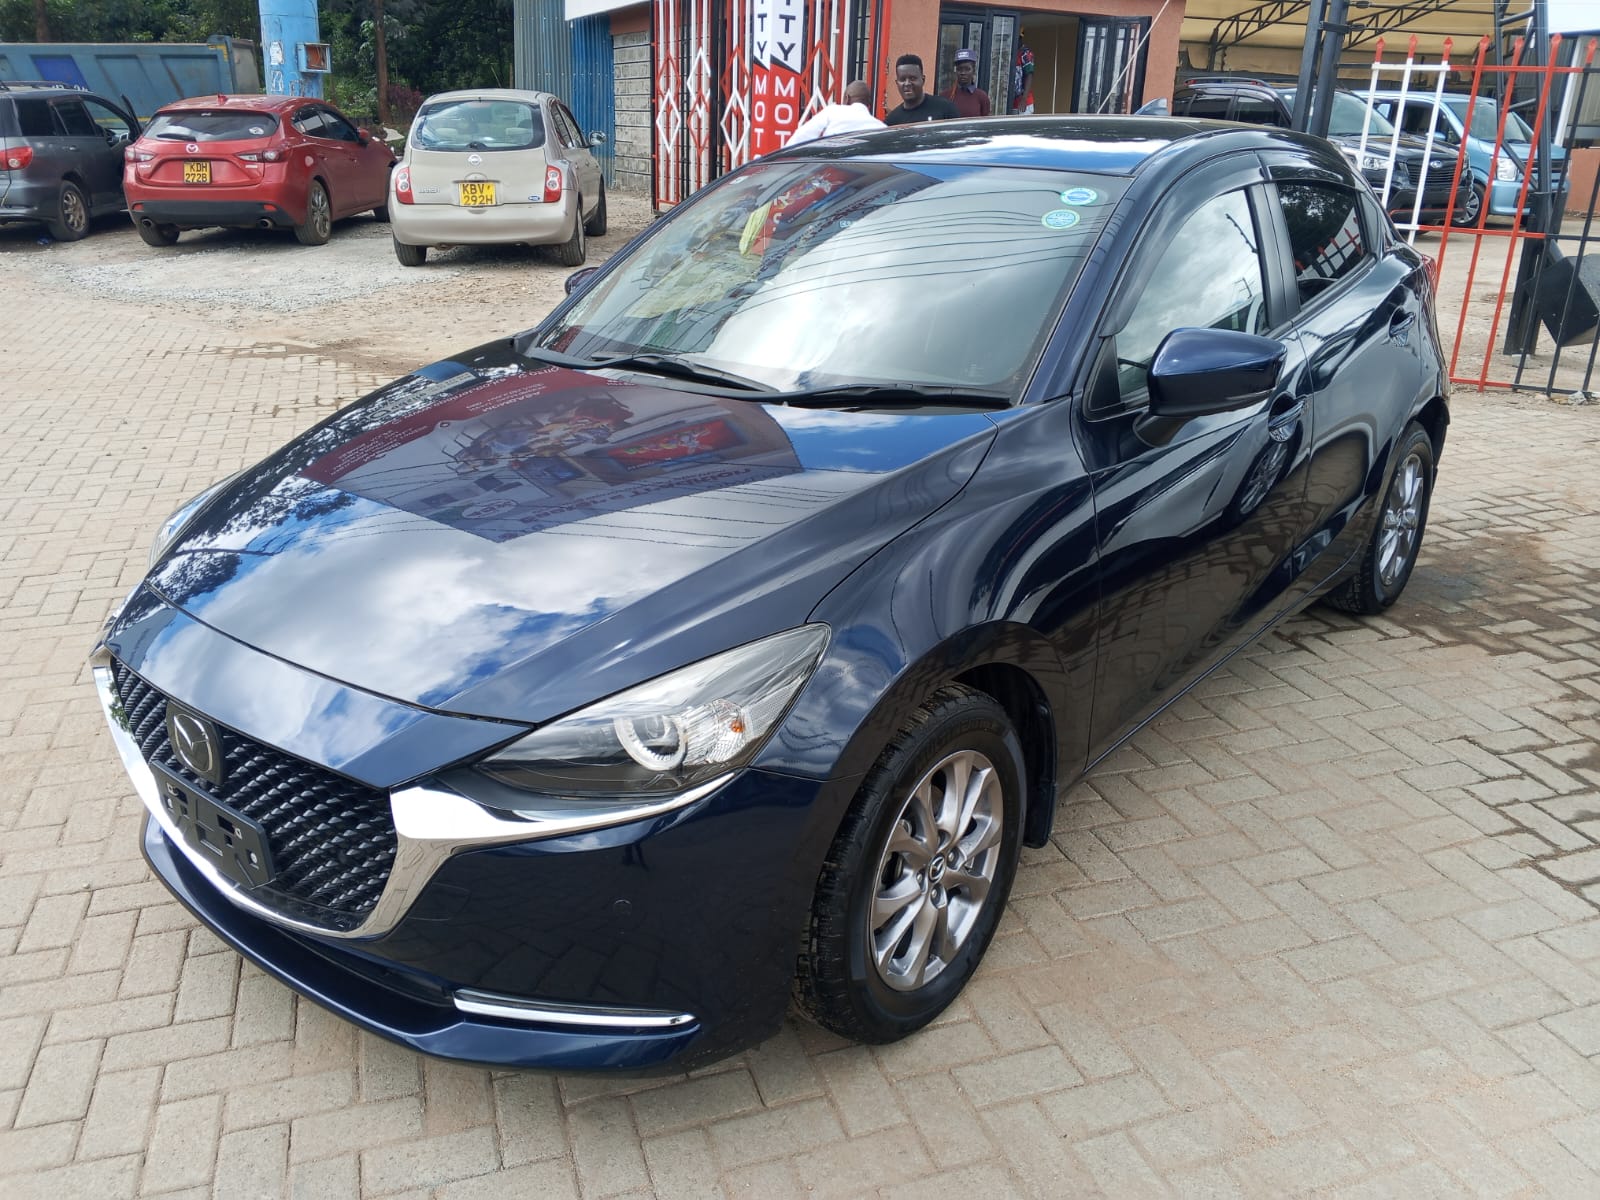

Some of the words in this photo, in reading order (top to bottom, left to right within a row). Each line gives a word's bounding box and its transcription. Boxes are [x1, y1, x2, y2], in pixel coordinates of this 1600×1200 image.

[757, 0, 767, 59] TY
[777, 0, 796, 61] TY
[754, 74, 767, 159] MOT
[190, 162, 208, 172] KDH
[185, 172, 208, 183] 272B
[462, 183, 485, 194] KBV
[463, 194, 493, 206] 292H
